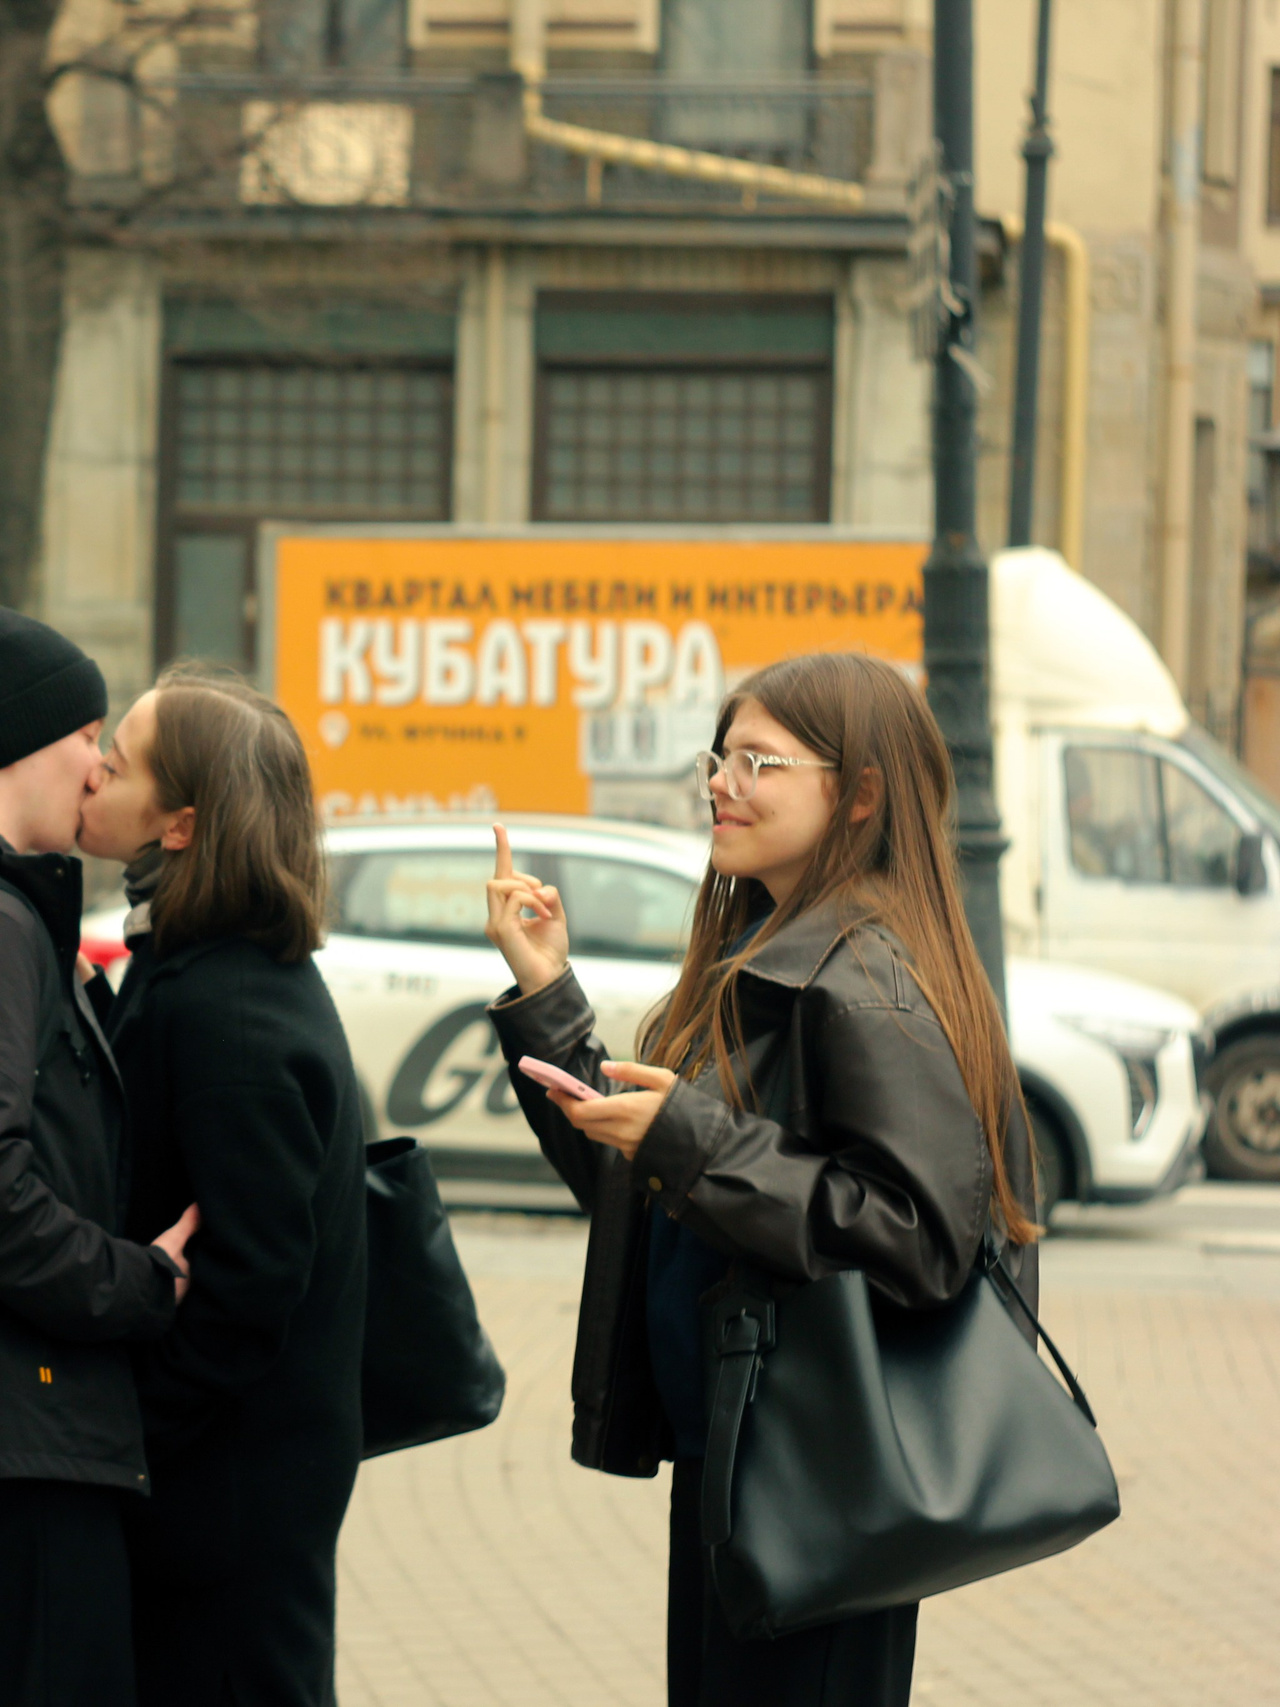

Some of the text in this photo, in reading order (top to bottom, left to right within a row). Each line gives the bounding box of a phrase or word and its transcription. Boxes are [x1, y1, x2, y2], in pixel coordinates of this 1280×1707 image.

[324, 577, 923, 616] КВАРТАЛ МЕБЕЛИ И ИНТЕРЬЕРА
[320, 616, 724, 708] КУБАТУРА
